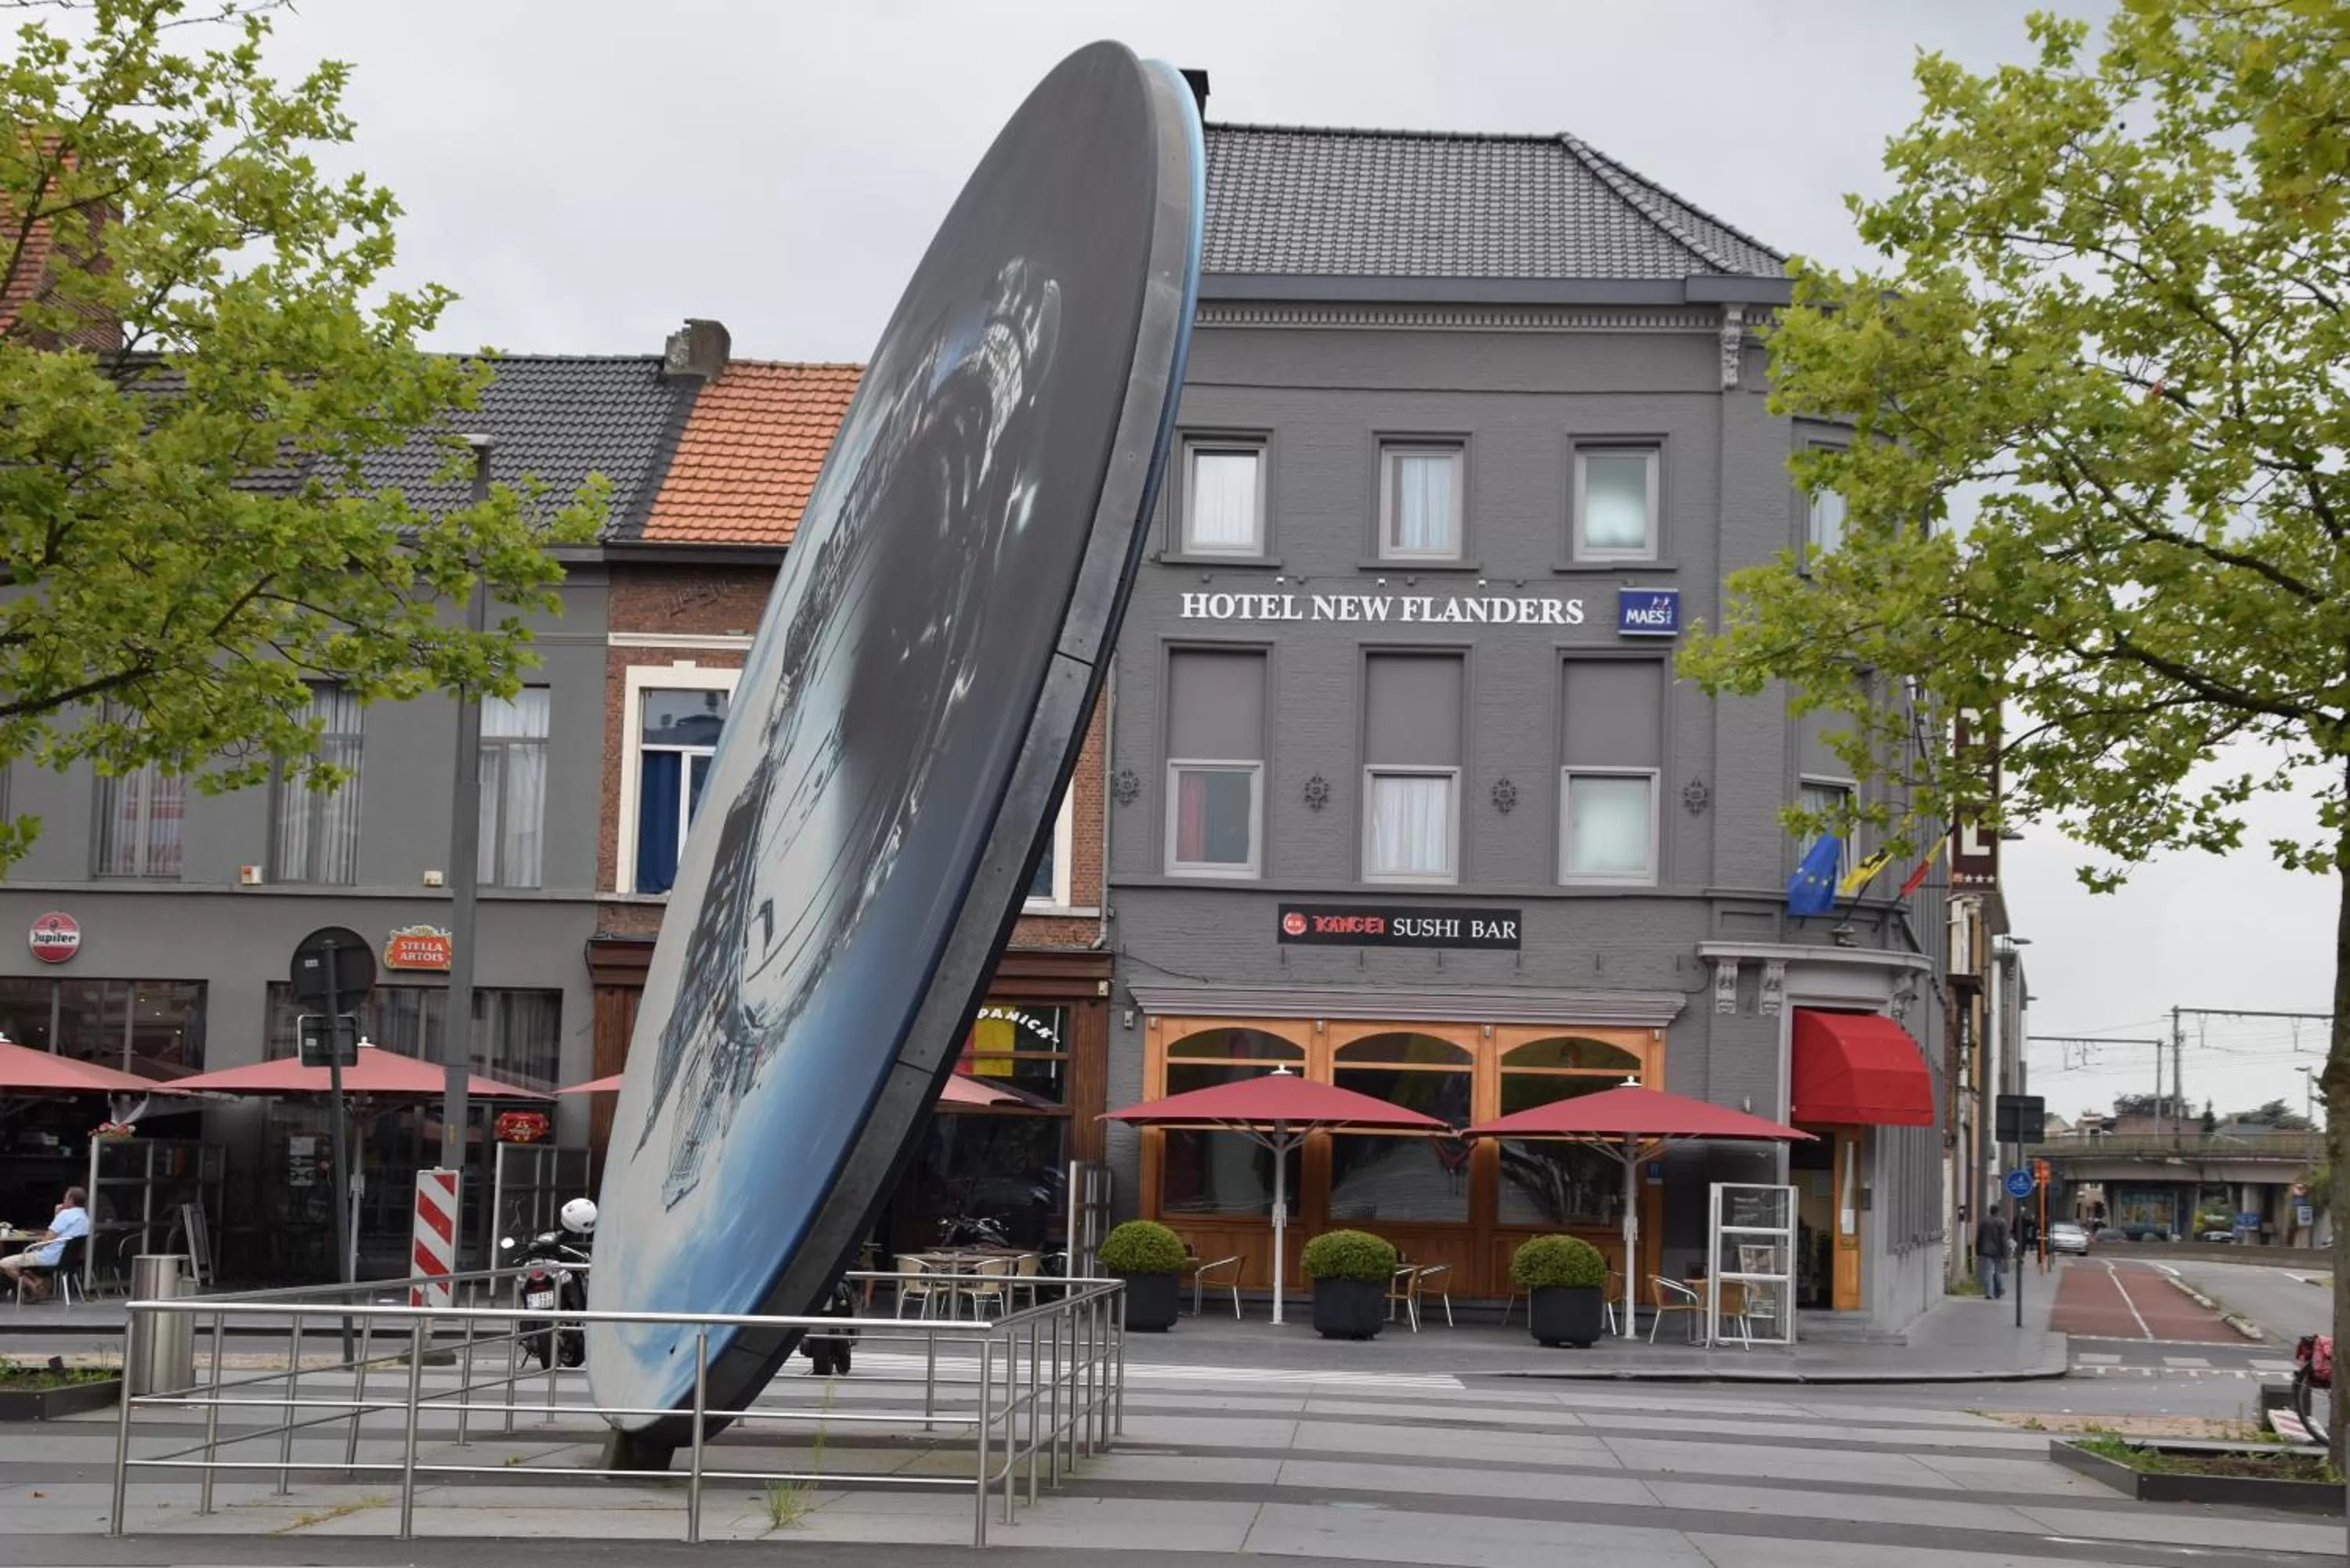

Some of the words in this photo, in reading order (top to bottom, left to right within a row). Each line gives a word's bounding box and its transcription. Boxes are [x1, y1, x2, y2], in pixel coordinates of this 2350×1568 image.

[1180, 593, 1303, 620] HOTEL
[1311, 595, 1394, 621] NEW
[1401, 597, 1585, 624] FLANDERS
[1625, 609, 1665, 624] MAES
[1393, 918, 1460, 938] SUSHI
[1471, 919, 1517, 939] BAR
[400, 941, 443, 952] STELLA
[400, 952, 444, 963] ARTOIS
